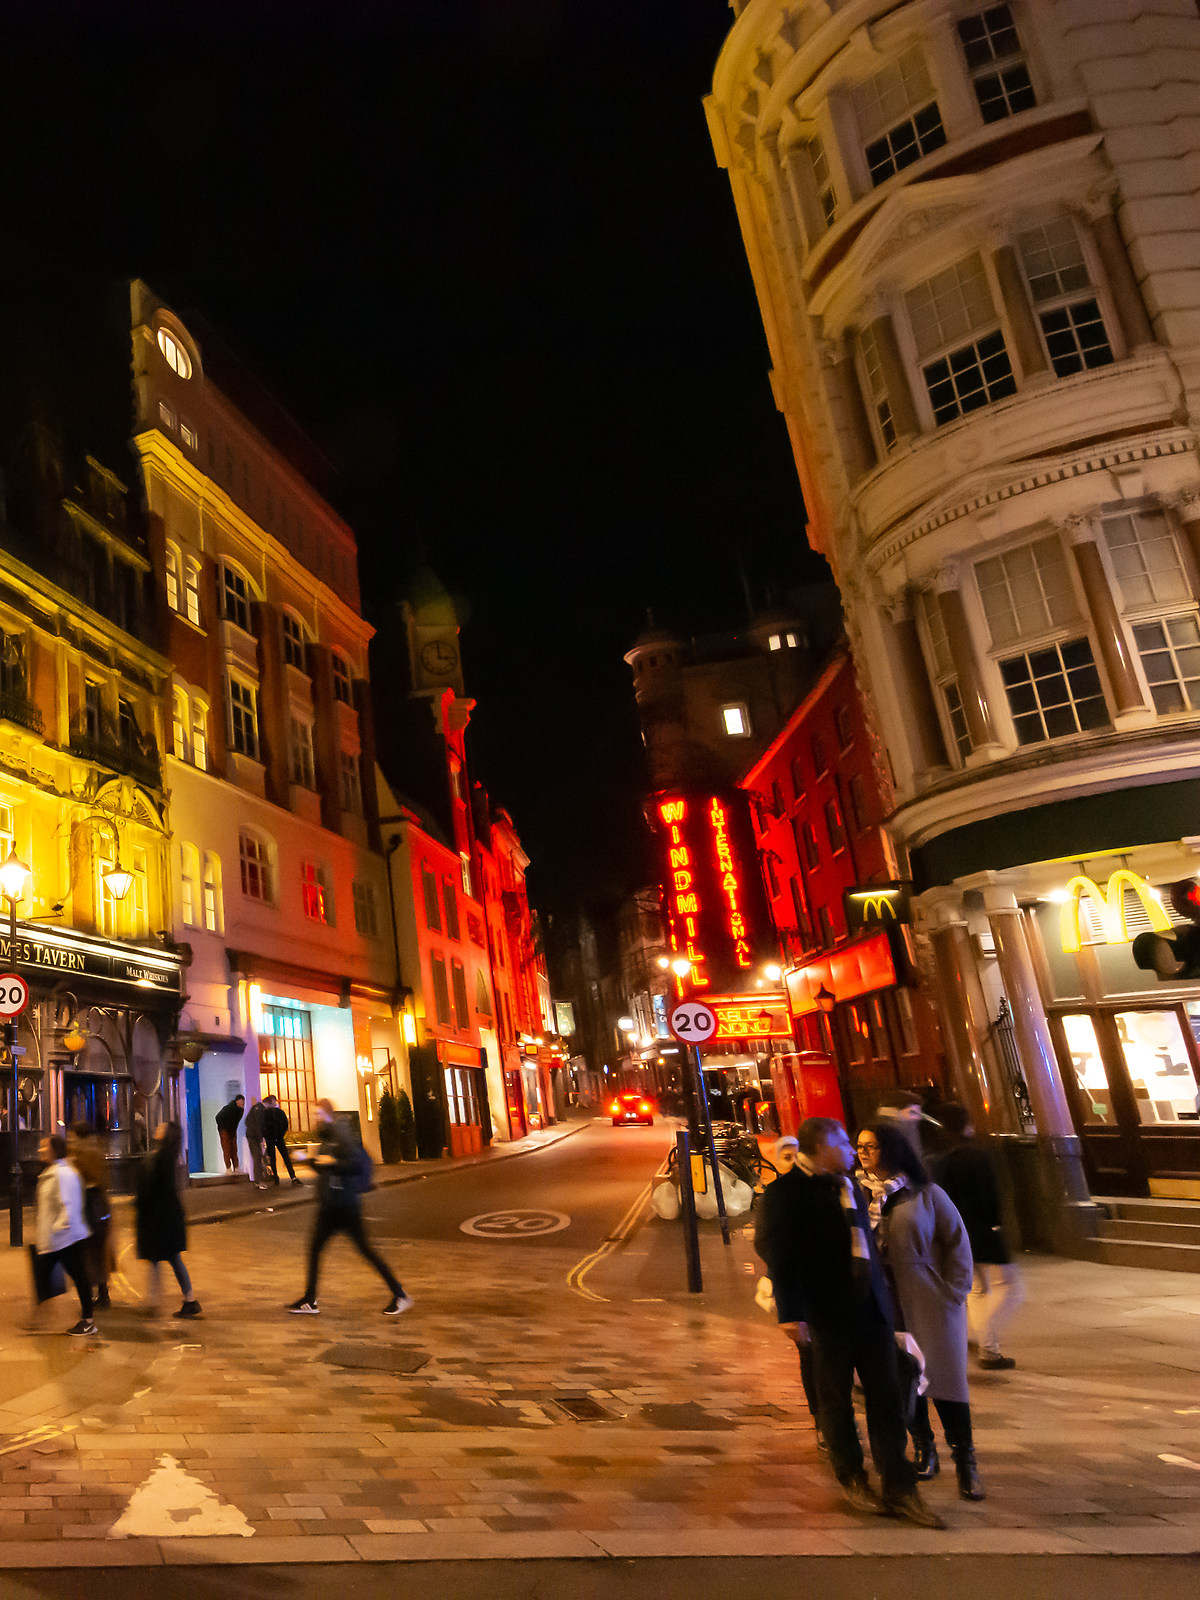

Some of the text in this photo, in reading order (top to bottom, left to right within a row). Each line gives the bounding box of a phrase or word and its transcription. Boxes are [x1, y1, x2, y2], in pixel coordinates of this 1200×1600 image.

[661, 801, 708, 985] WINDMILL
[711, 797, 750, 966] INTERNATIONAL
[33, 944, 86, 971] TAVERN
[125, 966, 143, 979] MALT
[674, 1012, 712, 1032] 20
